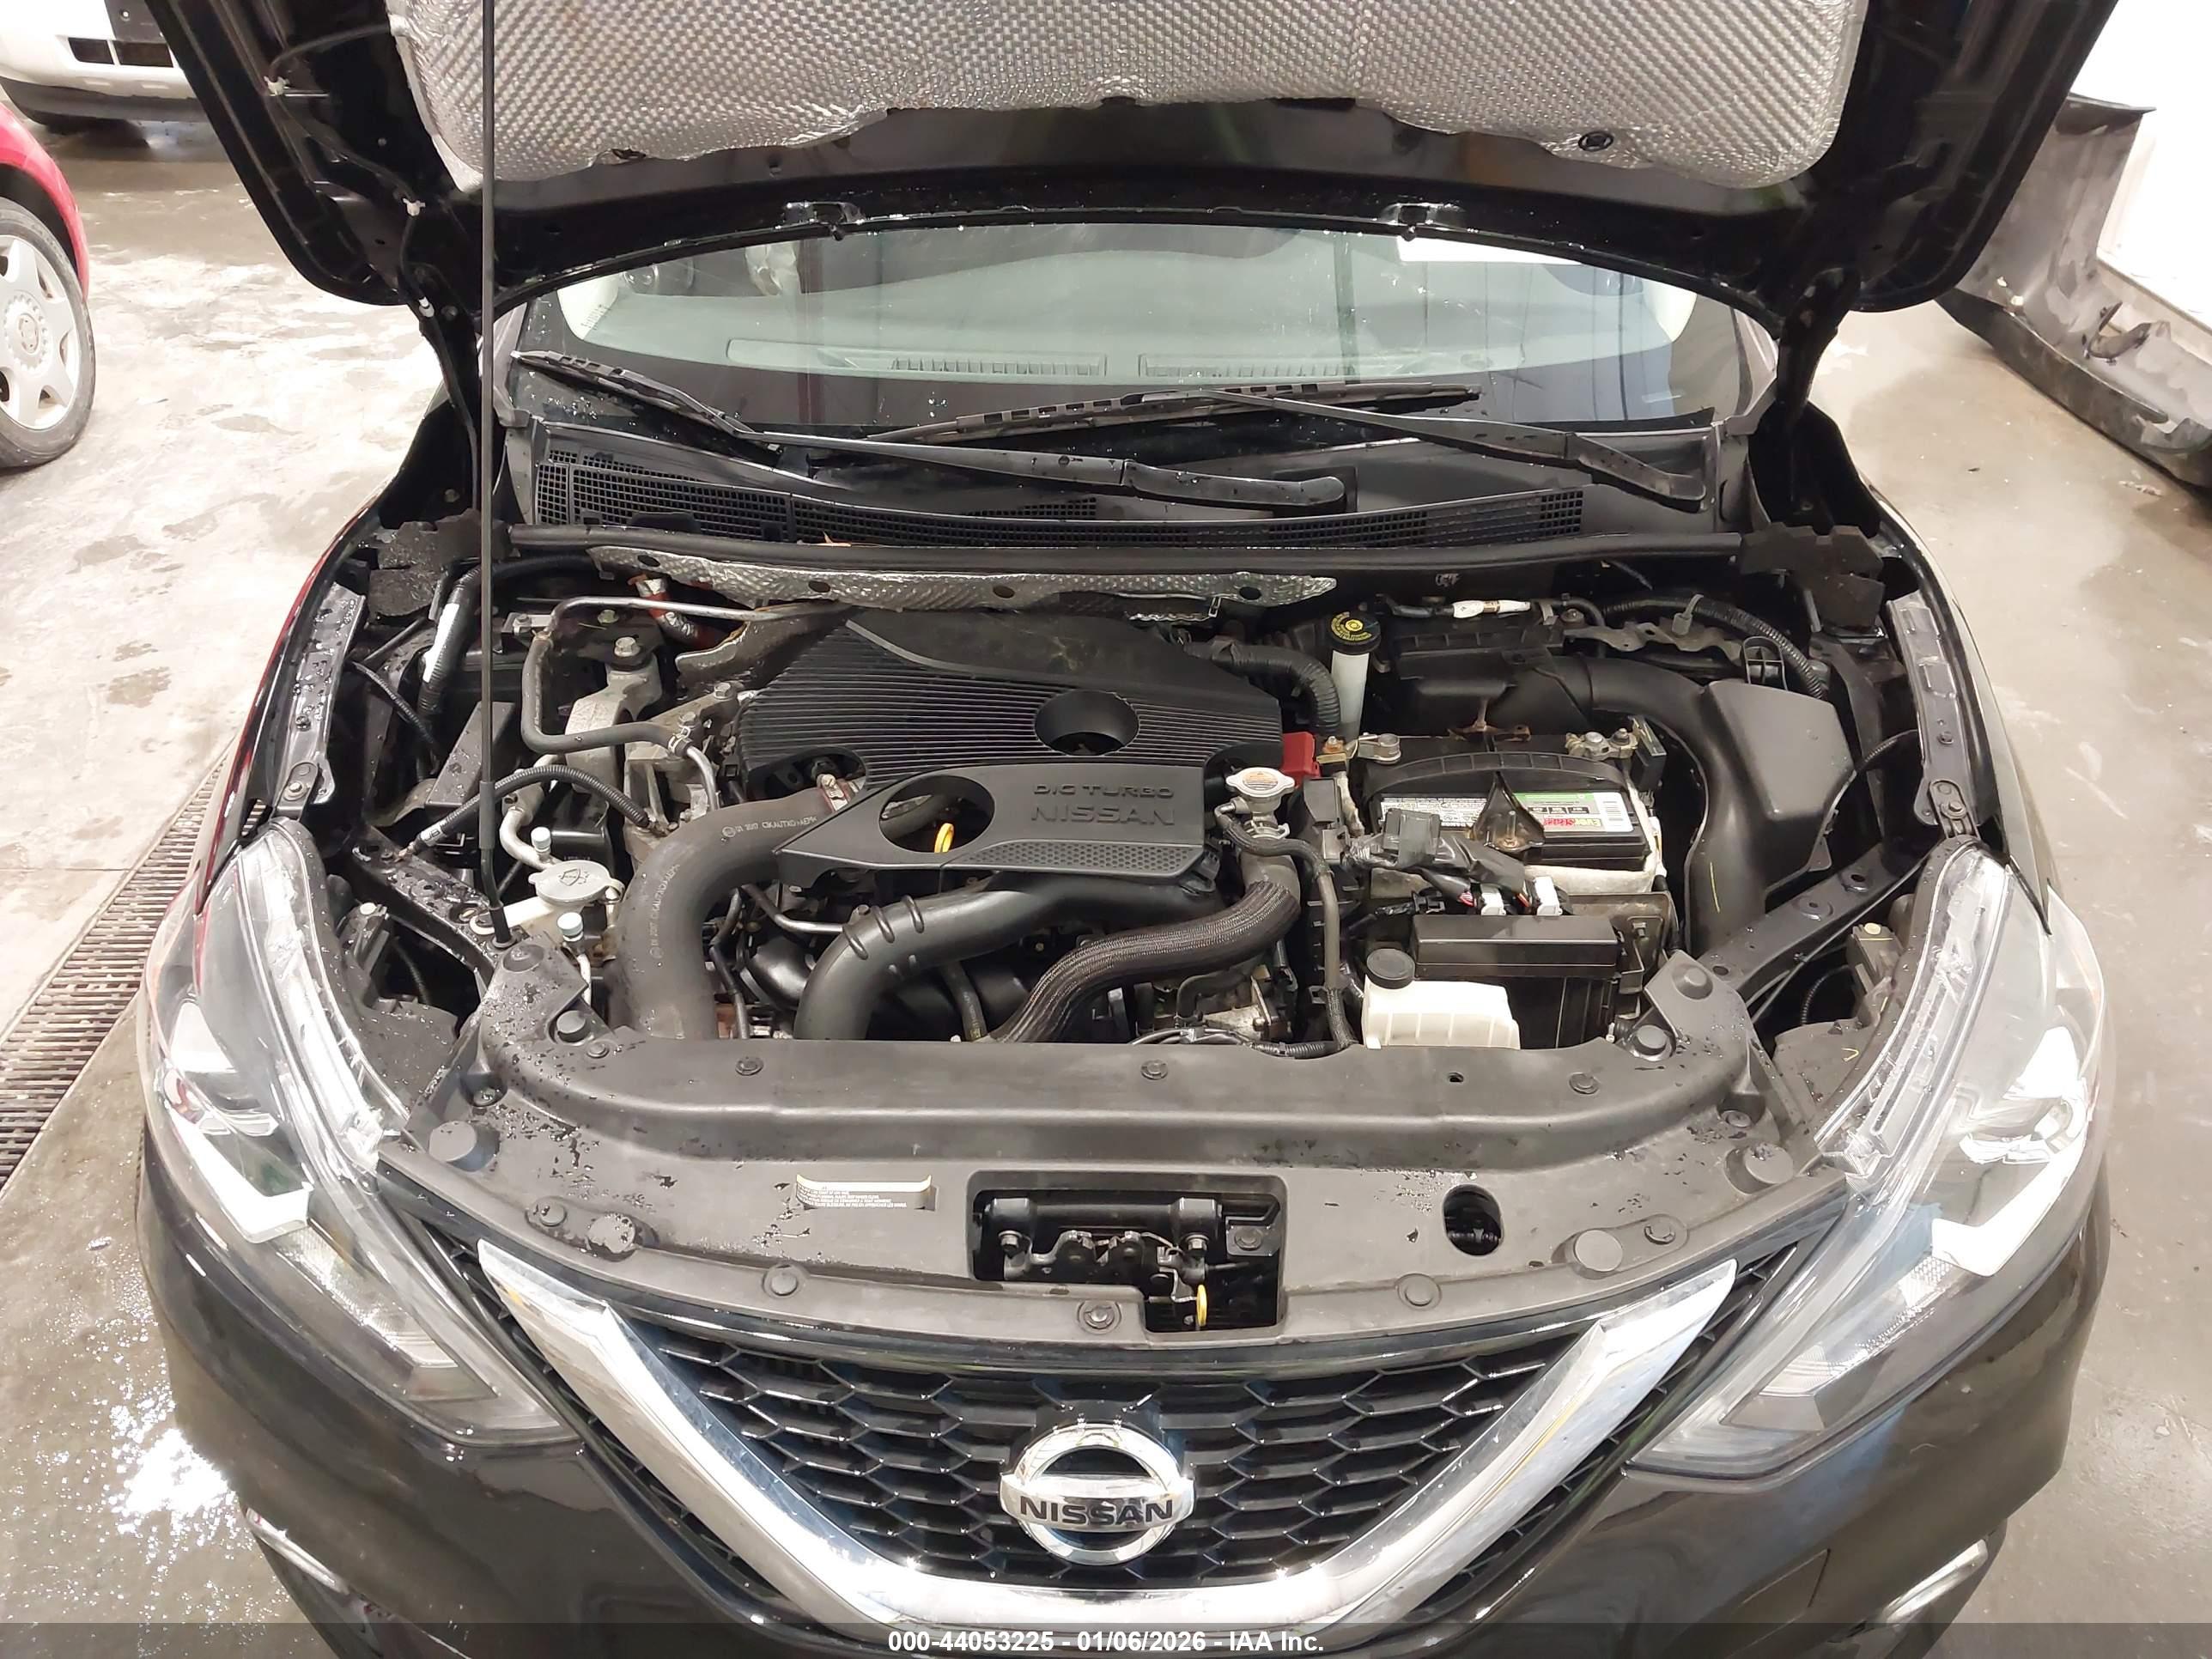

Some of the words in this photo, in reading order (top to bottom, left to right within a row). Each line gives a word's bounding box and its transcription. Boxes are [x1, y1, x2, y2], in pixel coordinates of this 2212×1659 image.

[1033, 783, 1076, 796] DIG
[1082, 784, 1175, 799] TURBO
[1030, 805, 1176, 826] NISSAN
[1019, 1495, 1174, 1527] NISSAN
